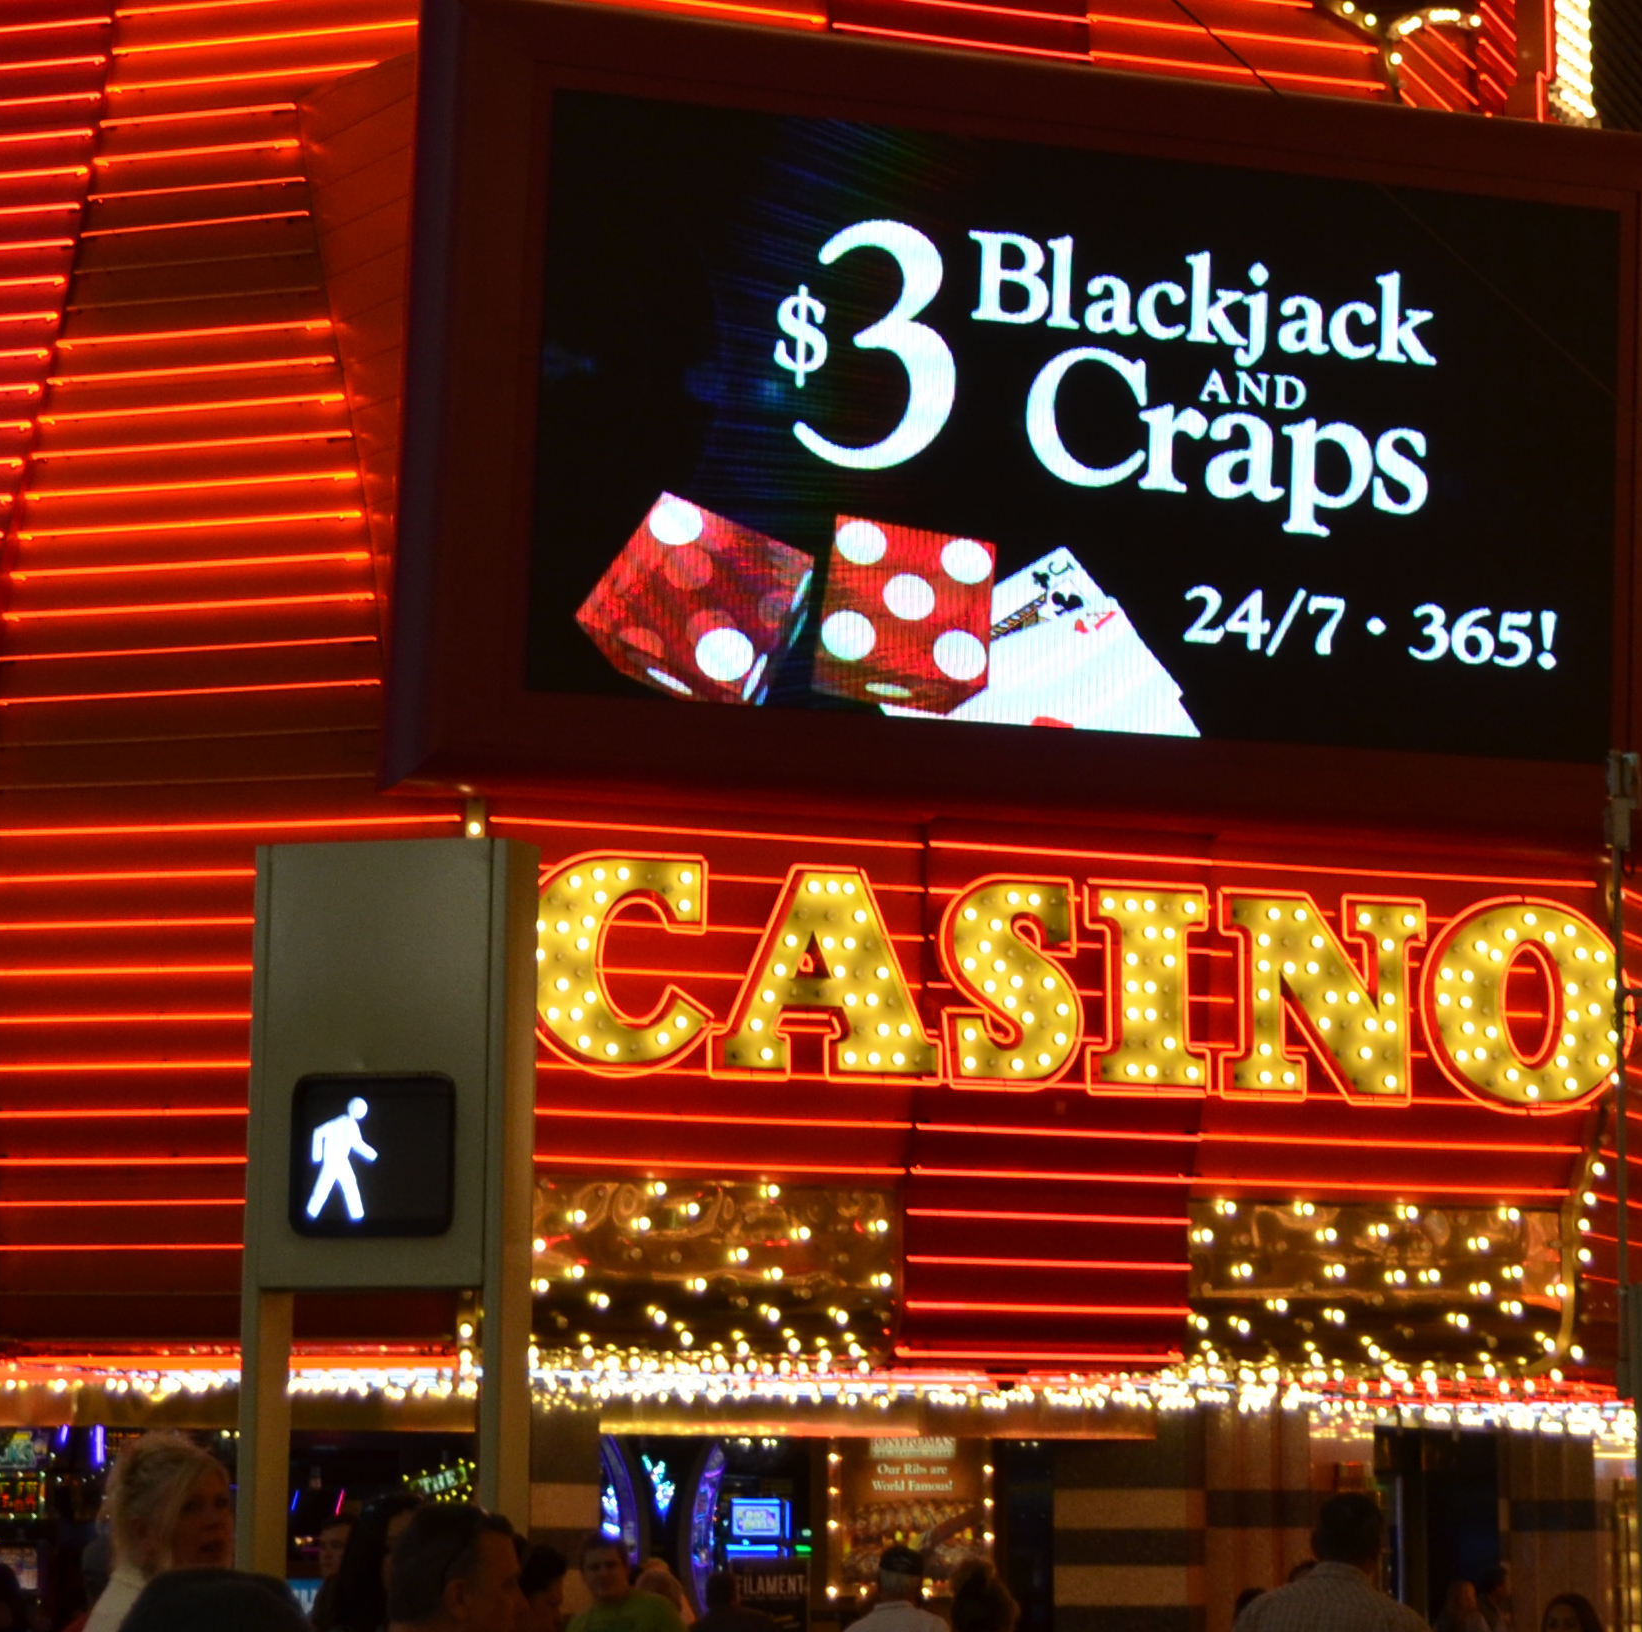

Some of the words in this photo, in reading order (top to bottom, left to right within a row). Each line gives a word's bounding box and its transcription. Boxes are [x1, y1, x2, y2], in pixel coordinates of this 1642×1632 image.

[773, 219, 957, 470] $3
[969, 229, 1436, 367] Blackjack
[1025, 346, 1430, 537] Craps
[1199, 368, 1308, 411] AND
[1182, 584, 1346, 658] 24/7
[1408, 604, 1558, 672] 365!
[537, 850, 1633, 1116] CASINO
[872, 1479, 905, 1491] World
[908, 1479, 953, 1491] Famous!
[877, 1463, 901, 1475] Our
[904, 1463, 928, 1475] Ribs
[930, 1465, 948, 1475] are
